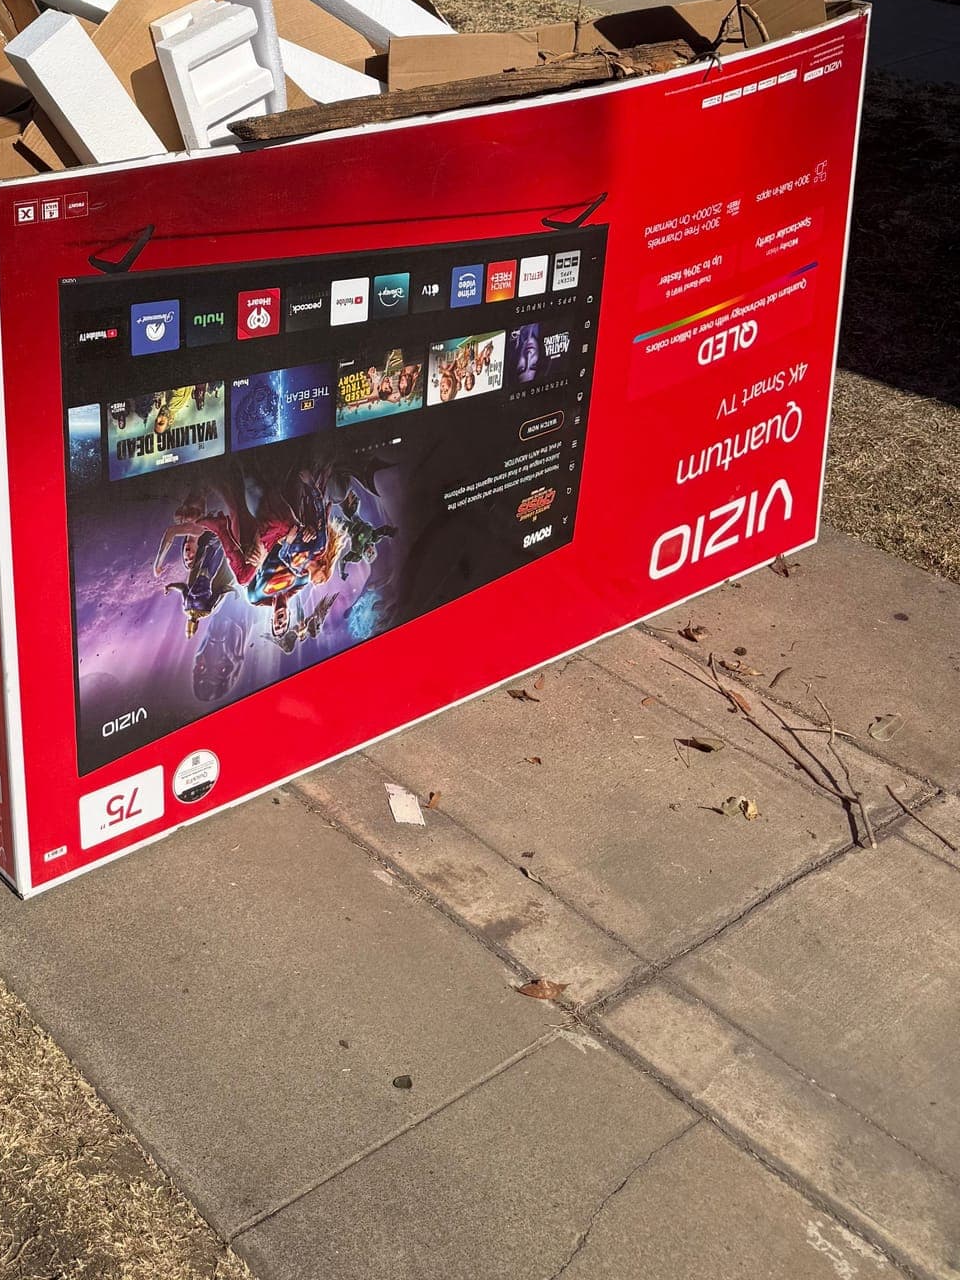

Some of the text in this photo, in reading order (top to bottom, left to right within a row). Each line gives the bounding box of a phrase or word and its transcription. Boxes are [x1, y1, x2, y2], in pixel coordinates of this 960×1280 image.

[823, 60, 842, 74] VIZIO
[756, 174, 810, 202] 300+ Built-in apps
[644, 202, 723, 238] 25,000+ On Demand
[648, 217, 720, 250] 300+ Free Channels
[755, 217, 812, 248] Spectacular clarity
[490, 272, 512, 281] FREE+
[523, 270, 543, 281] NETFLIX
[659, 254, 722, 286] Up to 30% faster
[458, 280, 476, 289] video
[491, 281, 511, 290] WATCH
[378, 287, 404, 300] Disney+
[458, 287, 476, 298] prime
[247, 297, 271, 307] iHeart
[293, 298, 322, 314] peacock
[336, 297, 354, 306] YouTube
[558, 296, 576, 305] APPS
[515, 302, 545, 314] INPUTS
[136, 311, 174, 324] Paramount+
[194, 312, 224, 327] hulu
[646, 278, 807, 353] Quantum dot technology with over a billion colors
[545, 340, 569, 356] AGATHA
[698, 319, 758, 366] QLED
[233, 378, 249, 387] hulu
[338, 371, 364, 387] STORY
[488, 374, 501, 388] Palm
[286, 386, 329, 403] THE BEAR
[341, 381, 360, 395] TRUE
[345, 387, 370, 402] BASED
[510, 379, 568, 400] TRENDING NOW
[716, 361, 808, 420] 4K Smart TV
[527, 418, 557, 433] WATCH NOW
[117, 420, 218, 460] WALKING DEAD
[676, 401, 802, 484] Quantum
[466, 484, 475, 492] the
[476, 478, 493, 489] against
[444, 486, 465, 500] epitome
[468, 493, 482, 503] space
[483, 489, 492, 498] and
[457, 497, 467, 507] join
[523, 524, 552, 548] ROW8
[649, 478, 793, 580] VIZIO
[102, 707, 148, 737] VIZIO
